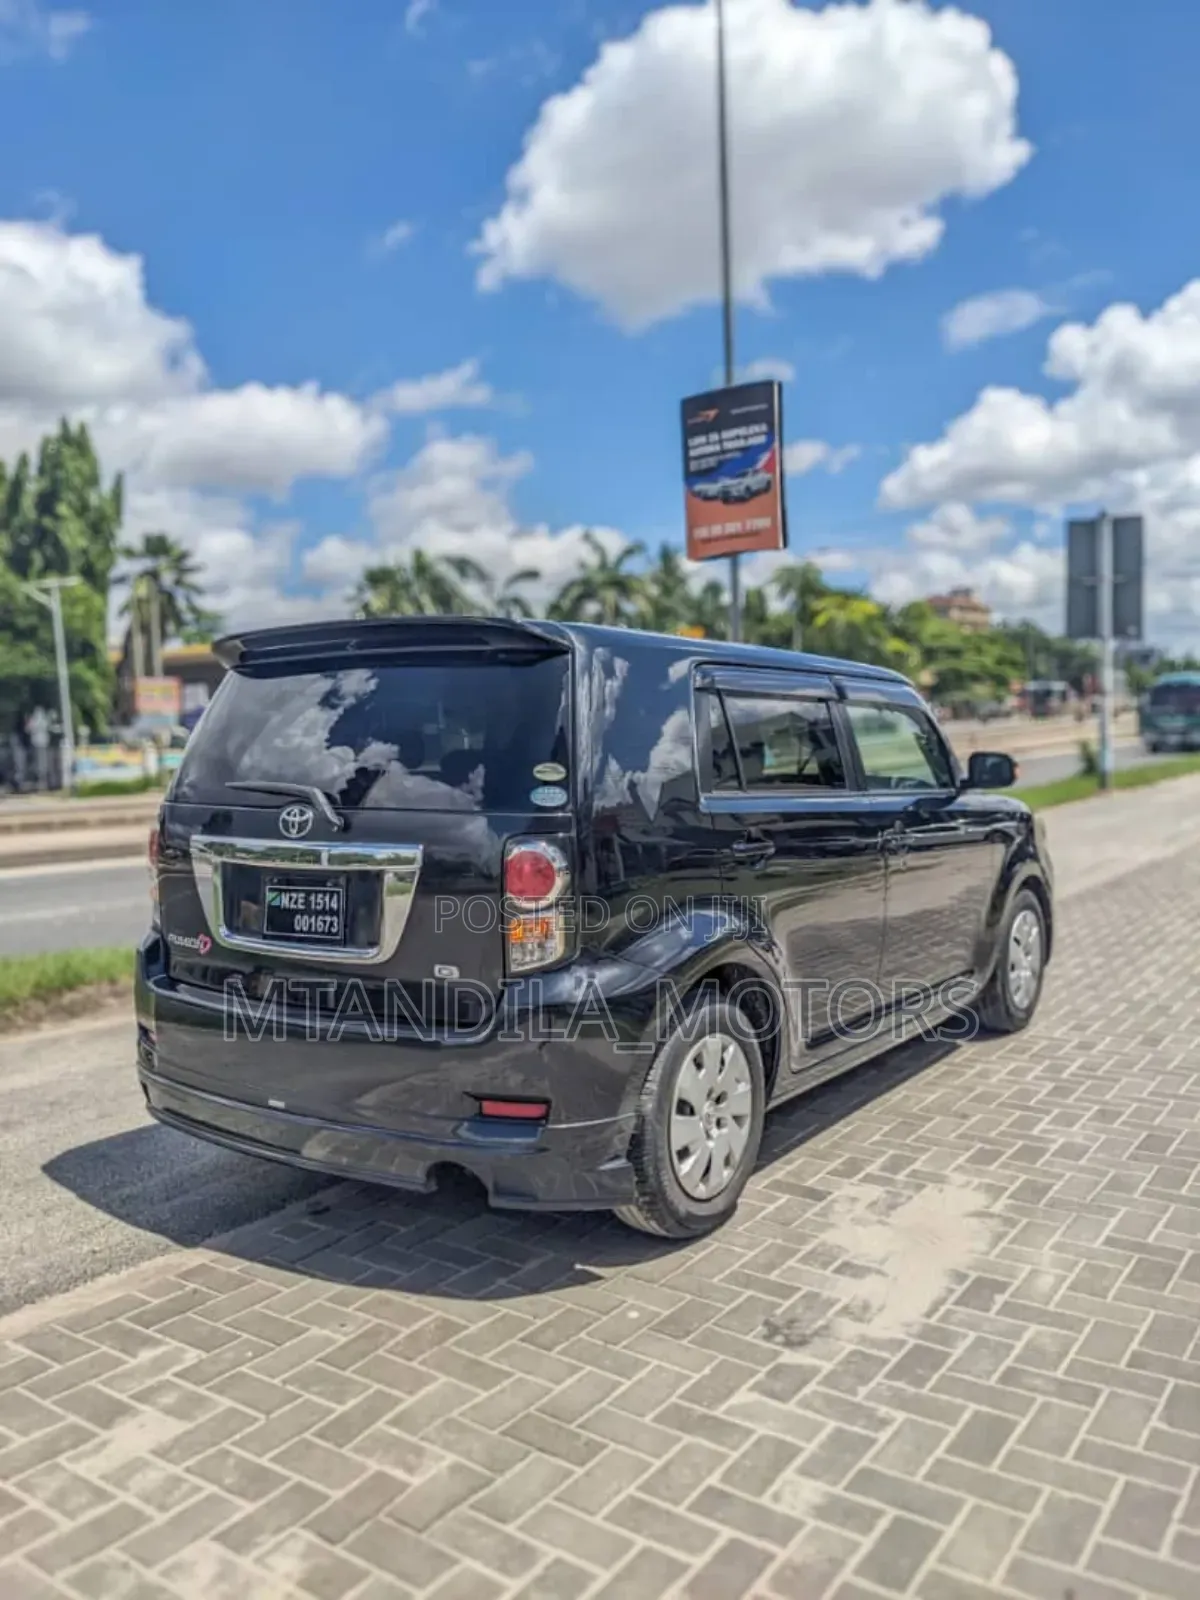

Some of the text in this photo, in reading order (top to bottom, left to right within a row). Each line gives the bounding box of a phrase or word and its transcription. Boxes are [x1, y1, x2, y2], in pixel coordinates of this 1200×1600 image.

[281, 891, 339, 911] NZE 1514
[293, 914, 339, 933] 001673
